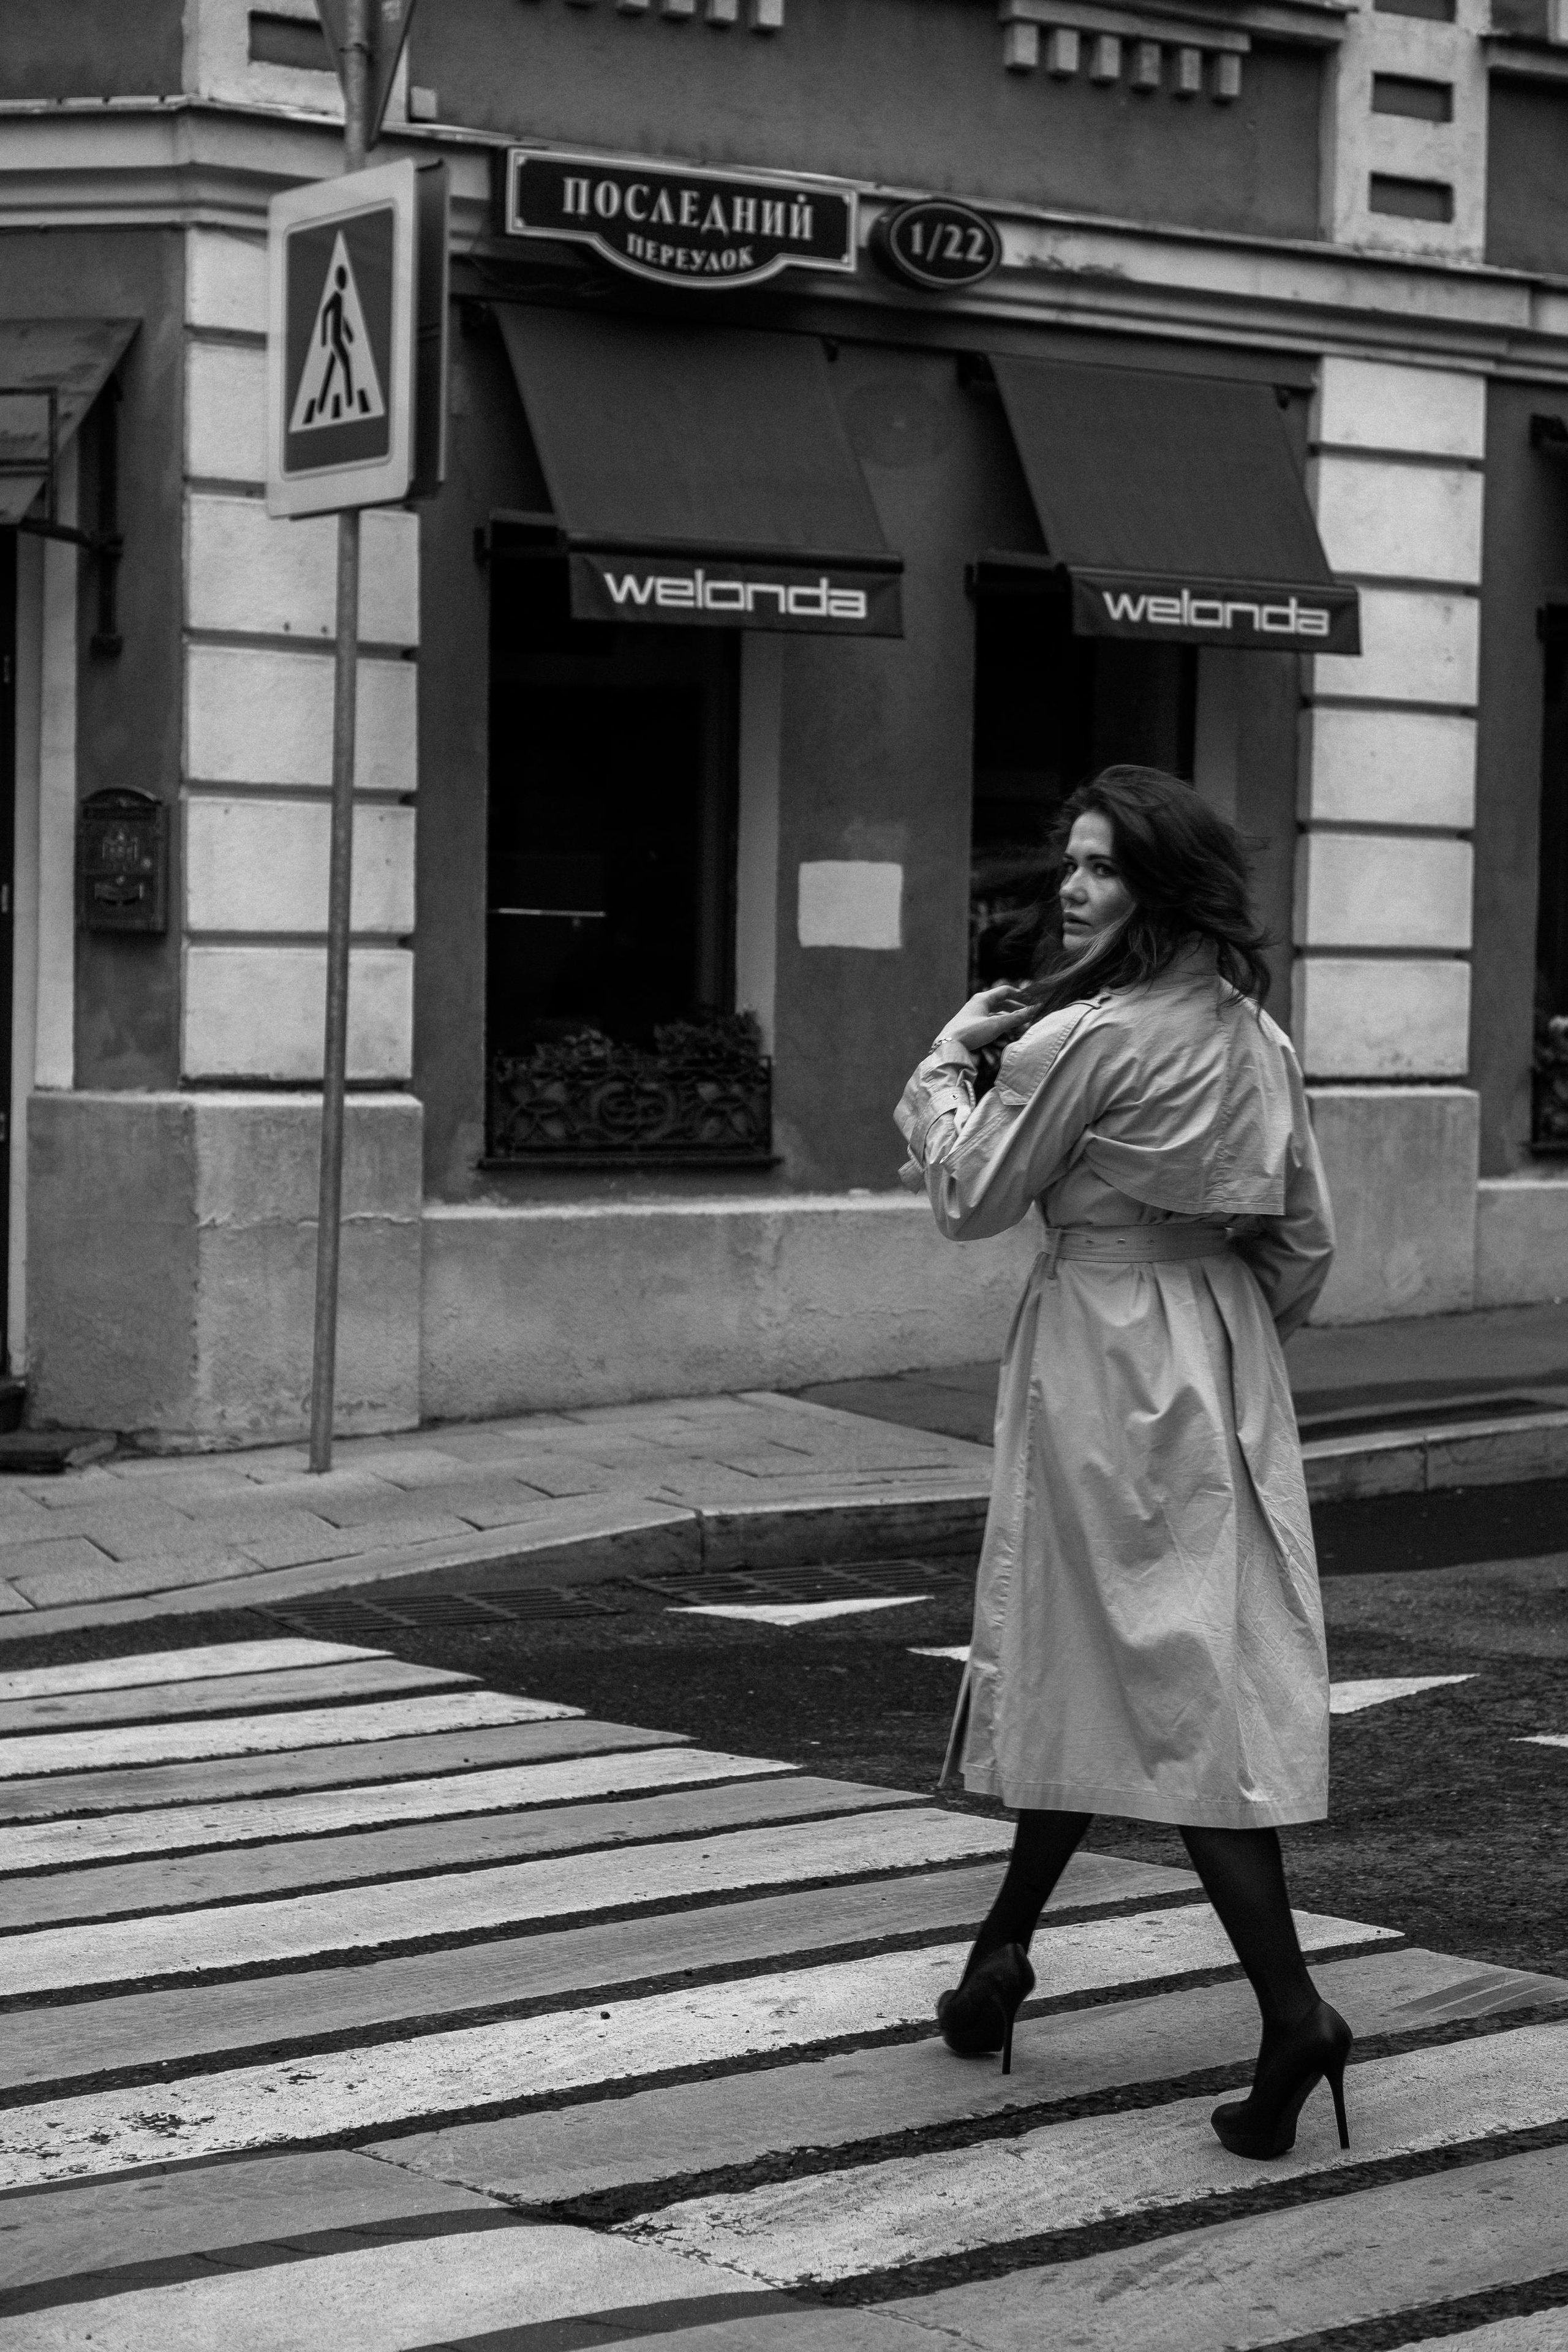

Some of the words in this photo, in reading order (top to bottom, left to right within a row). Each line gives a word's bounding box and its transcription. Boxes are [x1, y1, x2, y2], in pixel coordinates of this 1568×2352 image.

[562, 176, 814, 241] ПОСЛЕДНИЙ
[626, 232, 755, 272] ПЕРЕУЛОК
[910, 221, 987, 264] 1/22
[603, 568, 867, 619] welonda
[1103, 588, 1330, 636] welonda
